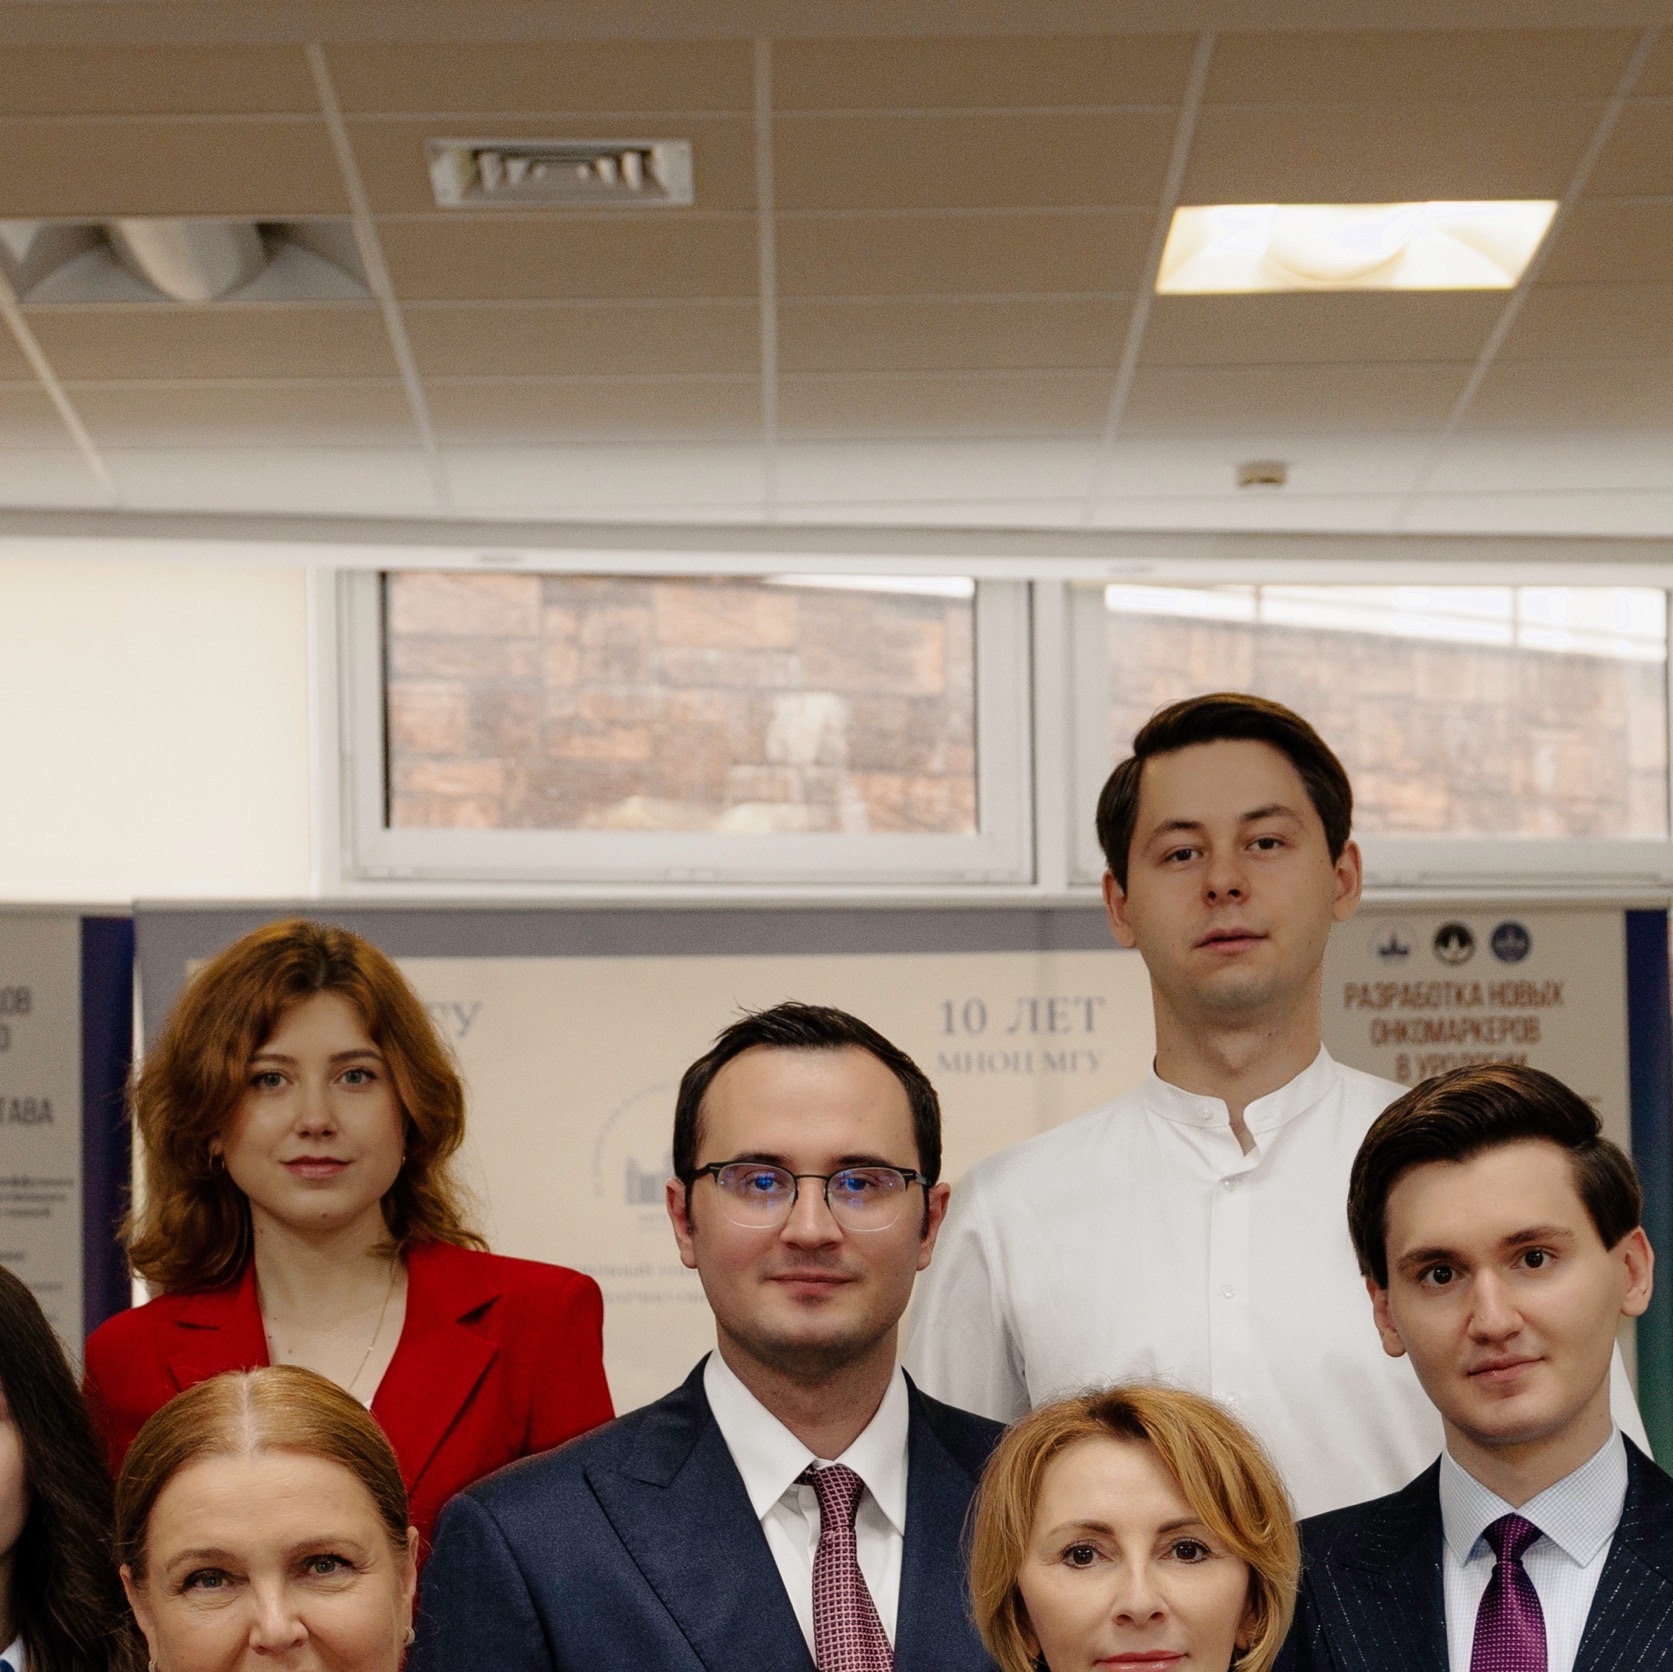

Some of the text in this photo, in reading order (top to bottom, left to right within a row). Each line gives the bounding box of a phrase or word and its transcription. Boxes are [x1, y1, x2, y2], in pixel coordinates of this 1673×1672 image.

[1343, 979, 1565, 1010] РАЗРАБОТКА НОВЫХ
[939, 996, 1107, 1036] 10 ЛЕТ
[1370, 1015, 1541, 1045] ОНКОМАРКЕРОВ
[1042, 1049, 1104, 1074] МГУ
